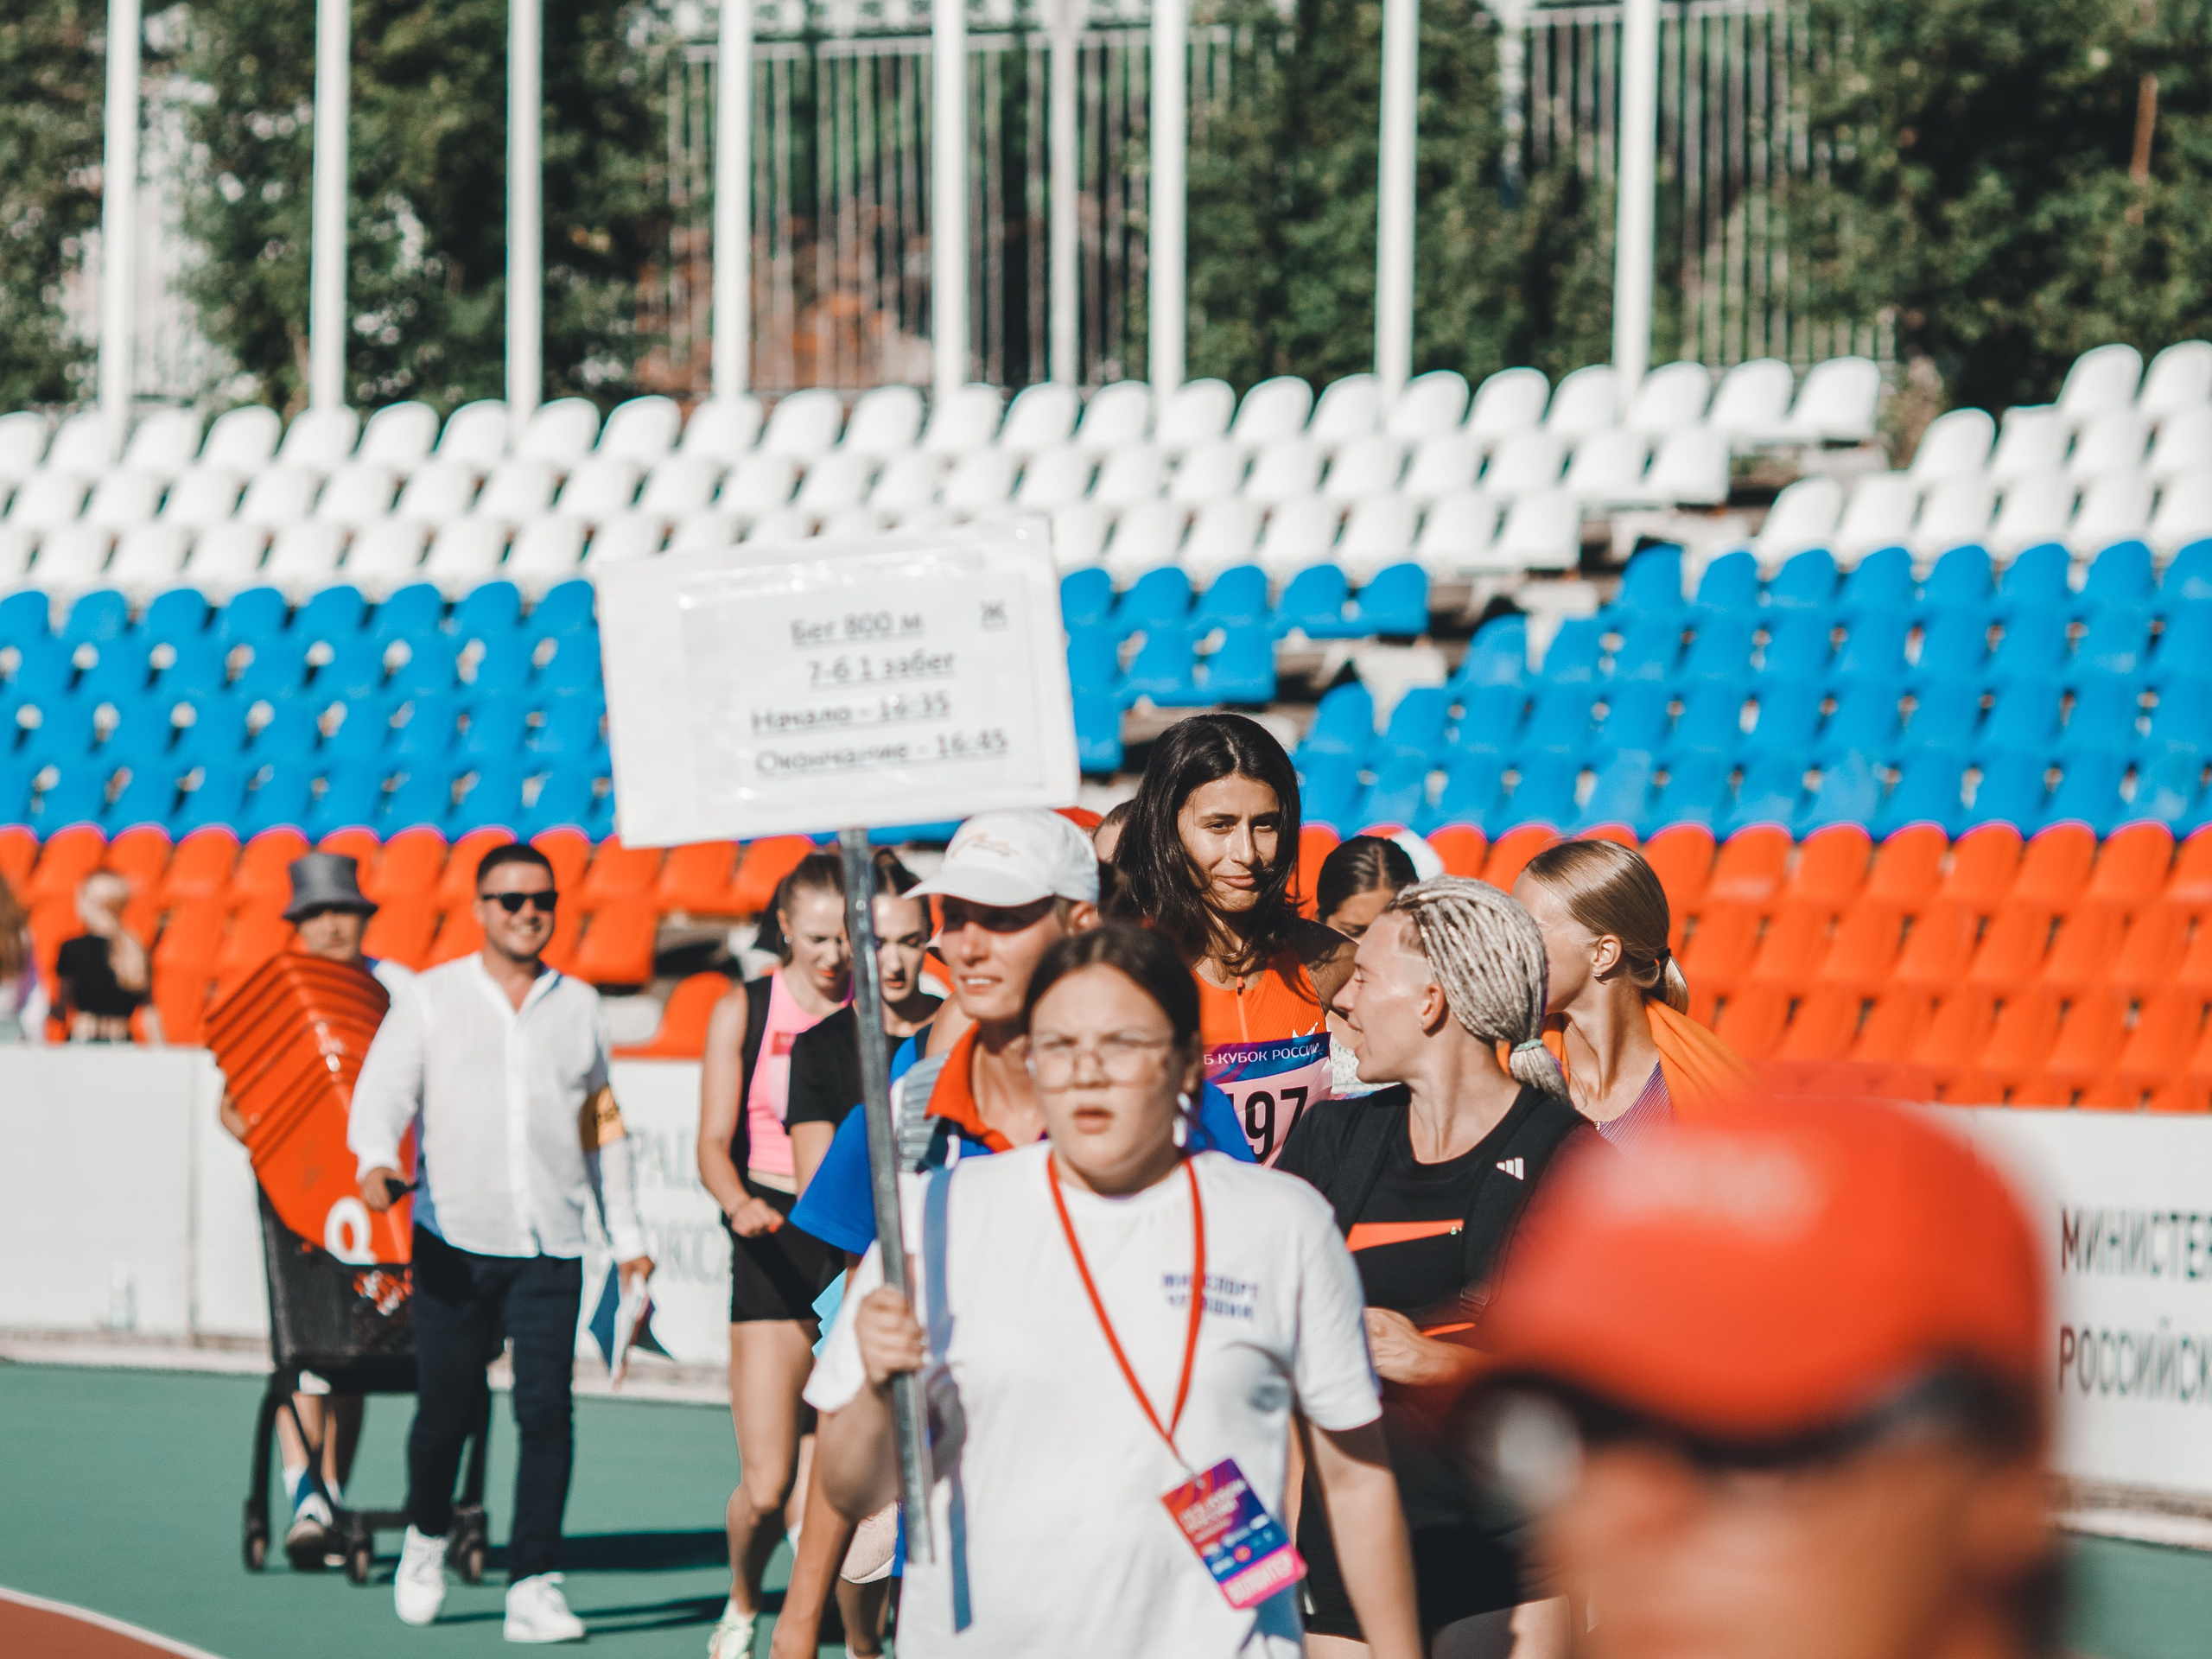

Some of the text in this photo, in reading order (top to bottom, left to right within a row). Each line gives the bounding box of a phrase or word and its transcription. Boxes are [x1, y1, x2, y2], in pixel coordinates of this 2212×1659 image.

[790, 618, 835, 642] Бег
[843, 612, 893, 639] 800
[900, 613, 924, 633] м
[859, 656, 873, 681] 1
[883, 648, 955, 678] забег
[751, 706, 852, 733] Начало
[754, 742, 908, 776] Окончание
[936, 727, 1008, 757] 16:45
[1217, 1050, 1268, 1065] КУБОК
[1227, 1086, 1308, 1164] 97
[2062, 1206, 2212, 1281] МИНИСТЕ
